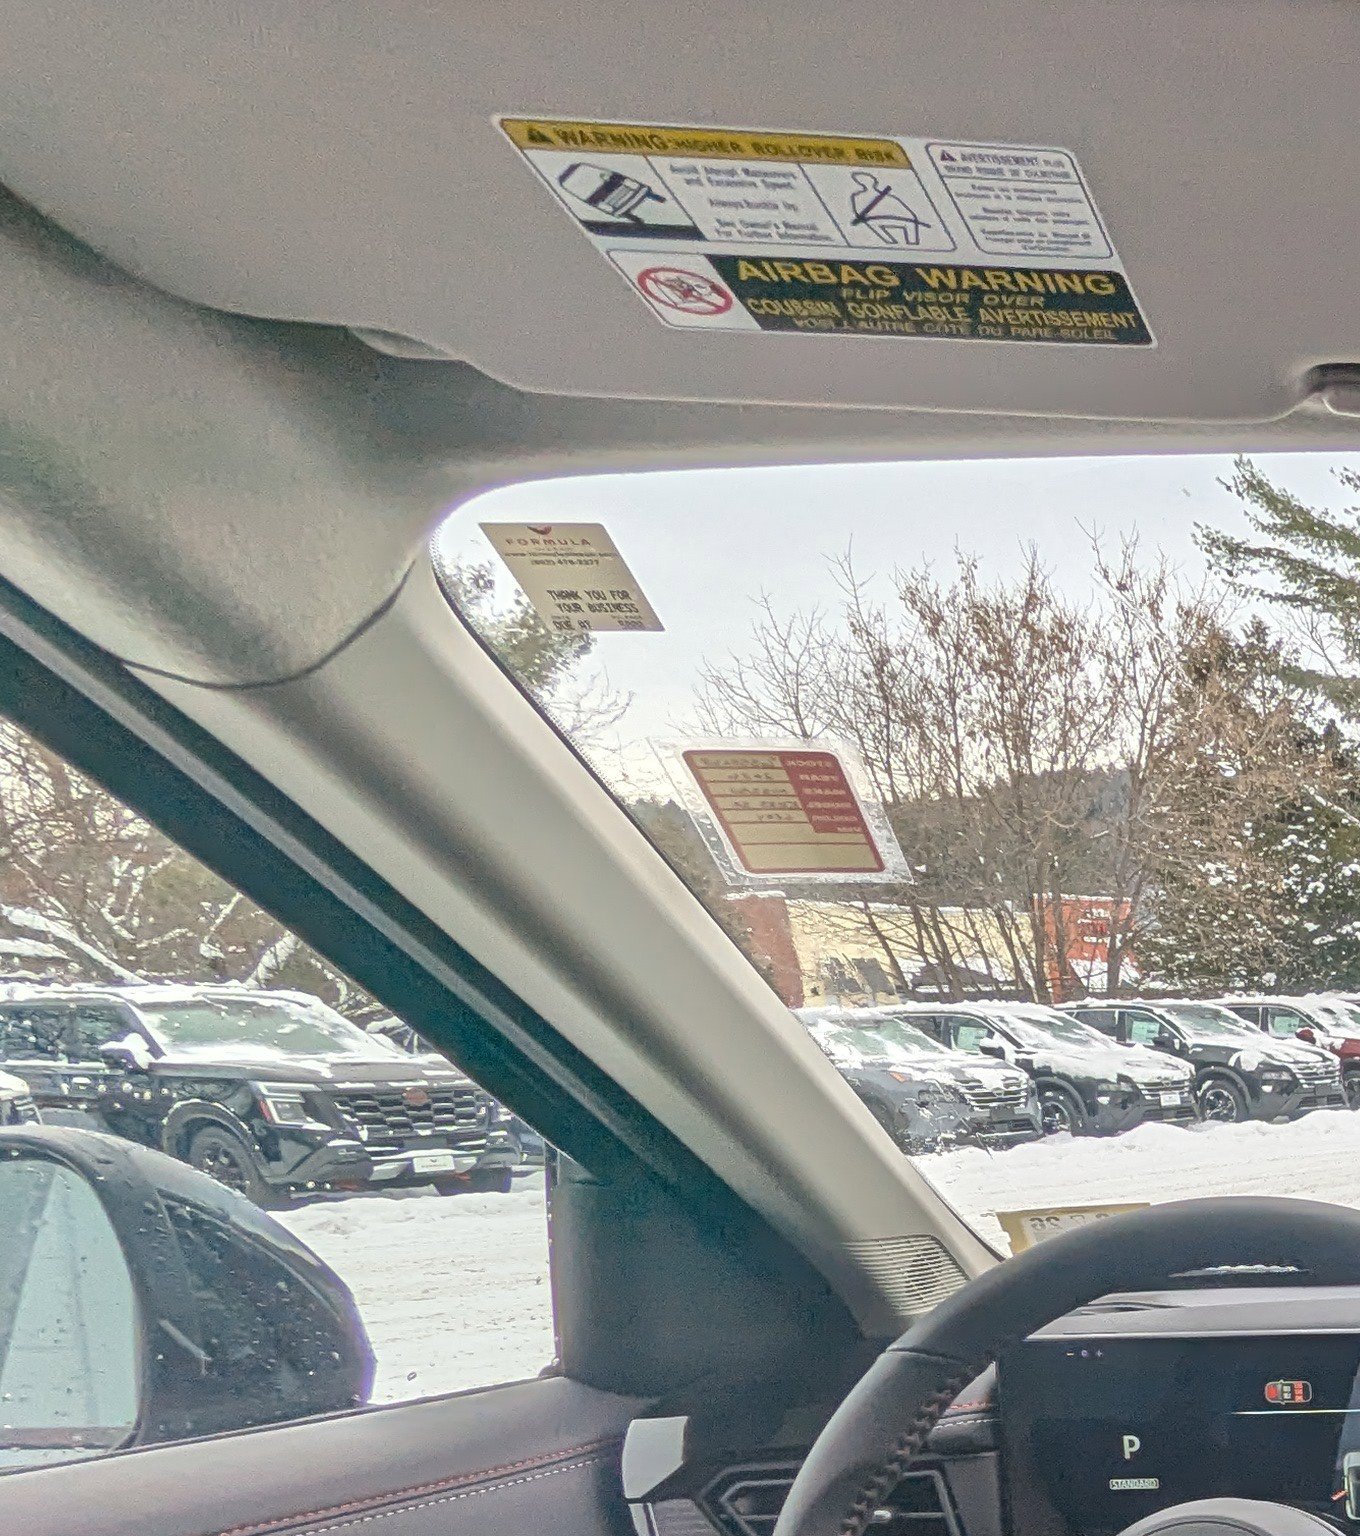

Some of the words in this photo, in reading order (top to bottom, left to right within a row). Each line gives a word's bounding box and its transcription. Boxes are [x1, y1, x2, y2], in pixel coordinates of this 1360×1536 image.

[738, 260, 900, 287] AIRBAG
[916, 267, 1117, 295] WARNING
[842, 287, 889, 299] FLIP
[903, 291, 970, 305] VISOR
[983, 295, 1044, 308] OVER
[748, 299, 841, 318] COUSSIN
[848, 303, 972, 323] GONFLABLE
[978, 307, 1138, 329] AVERTISSEMENT
[506, 538, 592, 546] FORMULA
[547, 590, 582, 600] THANK
[585, 590, 606, 600] YOU
[610, 590, 631, 600] FOR
[557, 603, 583, 613] YOUR
[588, 603, 639, 613] BUSINESS
[1122, 1435, 1141, 1460] P
[1111, 1479, 1159, 1489] STANDARD
